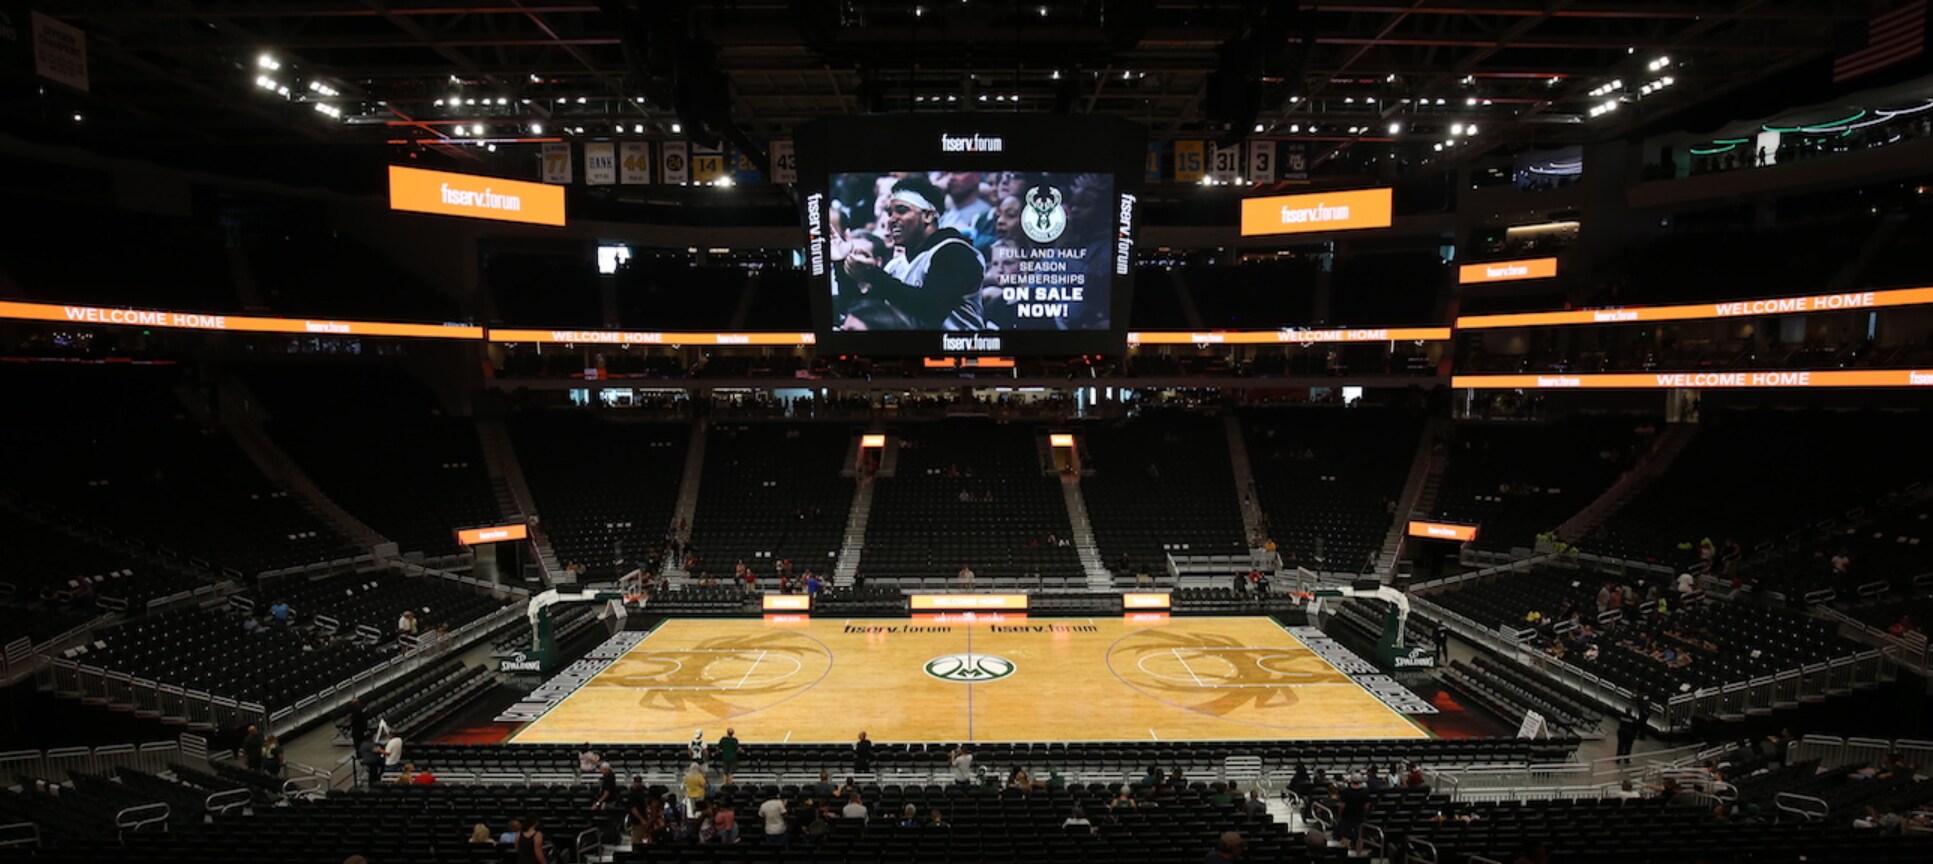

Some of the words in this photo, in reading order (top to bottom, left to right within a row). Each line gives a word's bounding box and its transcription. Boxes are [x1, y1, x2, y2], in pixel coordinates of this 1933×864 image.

[941, 133, 1002, 151] fiserv.forum
[545, 154, 568, 173] 77
[623, 154, 647, 171] 44
[699, 158, 716, 172] 14
[1179, 152, 1200, 172] 15
[1216, 152, 1235, 171] 31
[1256, 153, 1269, 171] 3
[440, 183, 521, 211] fiserv.forum
[1281, 203, 1349, 224] fiserv.forum
[807, 193, 826, 276] fiserv.forum
[1116, 193, 1137, 275] fiserv.forum
[999, 248, 1027, 258] FULL
[1030, 248, 1055, 258] AND
[1058, 248, 1087, 258] HALF
[1019, 261, 1067, 272] SEASON
[1000, 274, 1085, 285] MEMBERSHIPS
[1003, 287, 1029, 301] ON
[1035, 287, 1083, 301] SALE
[1018, 304, 1068, 317] NOW!
[1715, 297, 1808, 316] WELCOME
[1813, 292, 1875, 309] HOME
[64, 306, 168, 326] WELCOME
[173, 314, 226, 329] HOME
[551, 331, 621, 343] WELCOME
[624, 332, 664, 343] HOME
[943, 333, 1001, 351] fiserv.forum
[1277, 330, 1344, 342] WELCOME
[1347, 329, 1388, 341] HOME
[1656, 373, 1746, 387] WELCOME
[1752, 372, 1811, 386] HOME
[843, 625, 952, 633] fiserv.forum
[990, 624, 1098, 633] fiserv.forum
[500, 660, 541, 671] SPALDING
[1394, 656, 1435, 667] SPALDING
